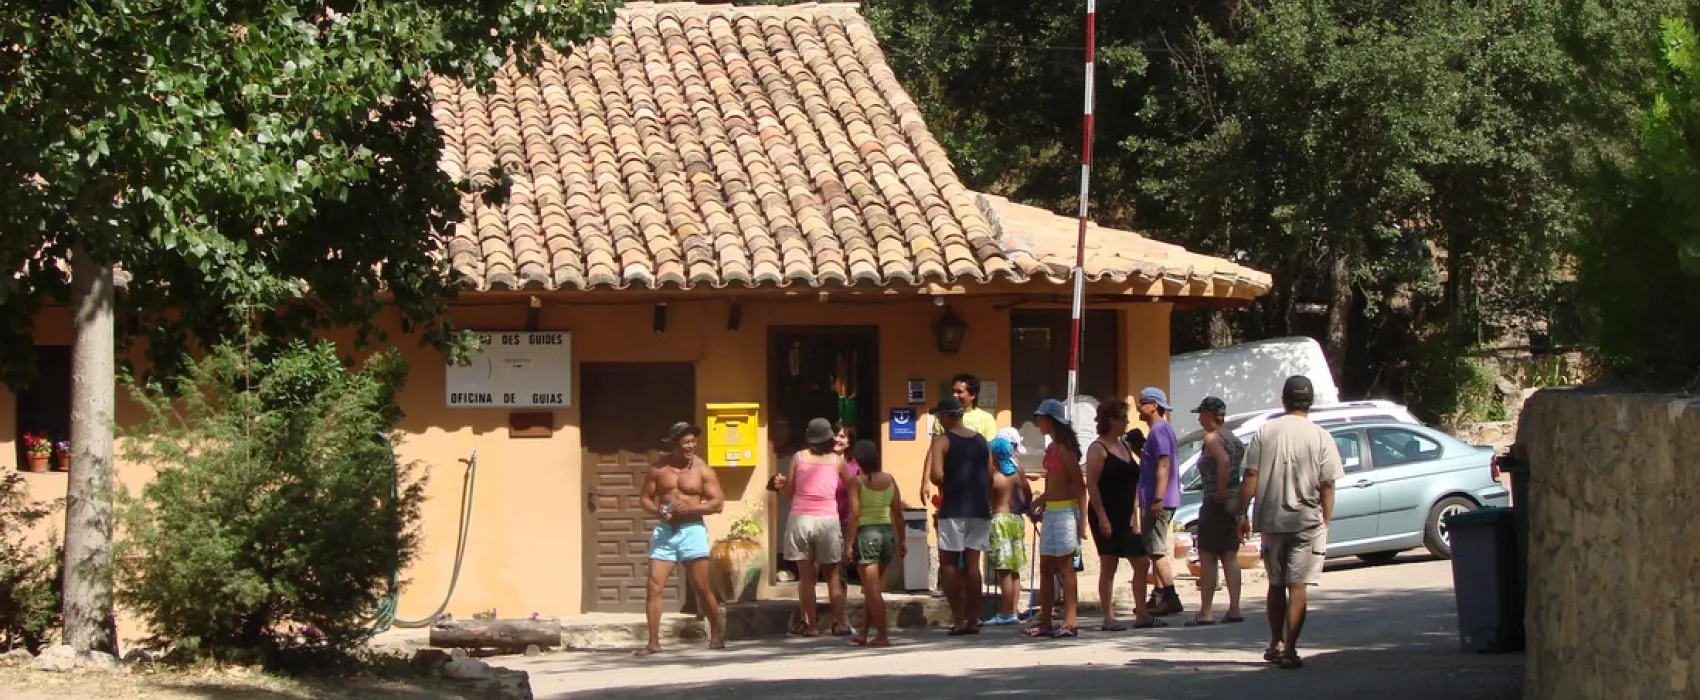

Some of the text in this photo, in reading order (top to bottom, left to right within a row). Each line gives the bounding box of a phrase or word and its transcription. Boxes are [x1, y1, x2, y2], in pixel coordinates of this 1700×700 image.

[501, 333, 520, 346] DES
[528, 333, 563, 346] GUIDES
[450, 392, 563, 405] OFICINA DE GUIAS
